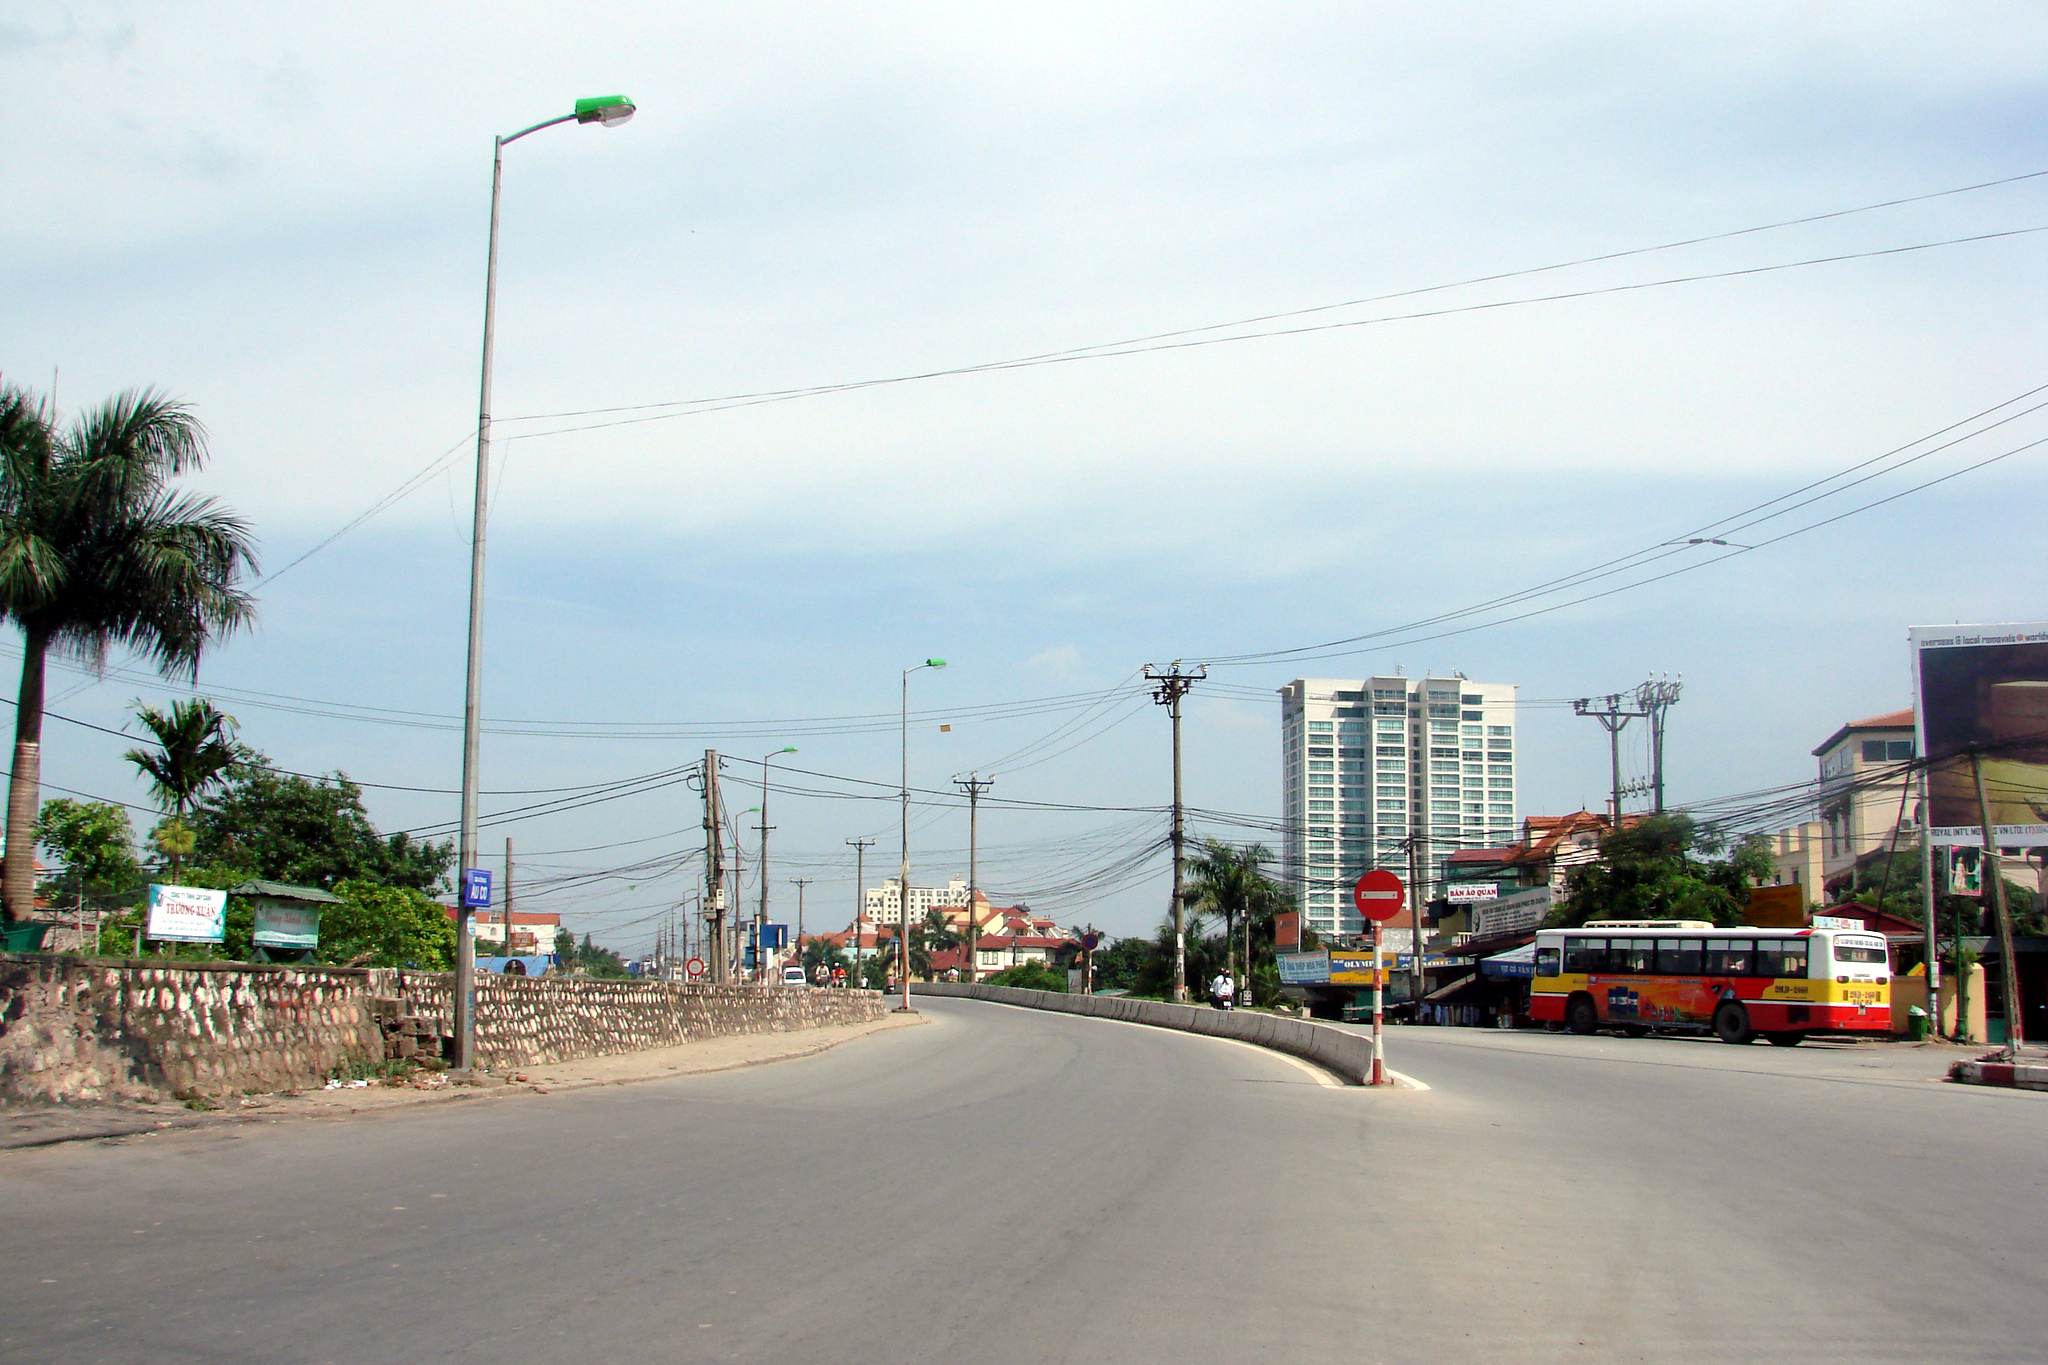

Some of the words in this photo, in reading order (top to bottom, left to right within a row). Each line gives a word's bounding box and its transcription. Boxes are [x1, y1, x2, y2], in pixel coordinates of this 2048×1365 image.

[1921, 639, 1953, 647] overseas
[1963, 635, 1979, 644] local
[1982, 633, 2015, 643] removals
[1931, 828, 1951, 836] ROYAL
[1344, 960, 1376, 968] OLYMP
